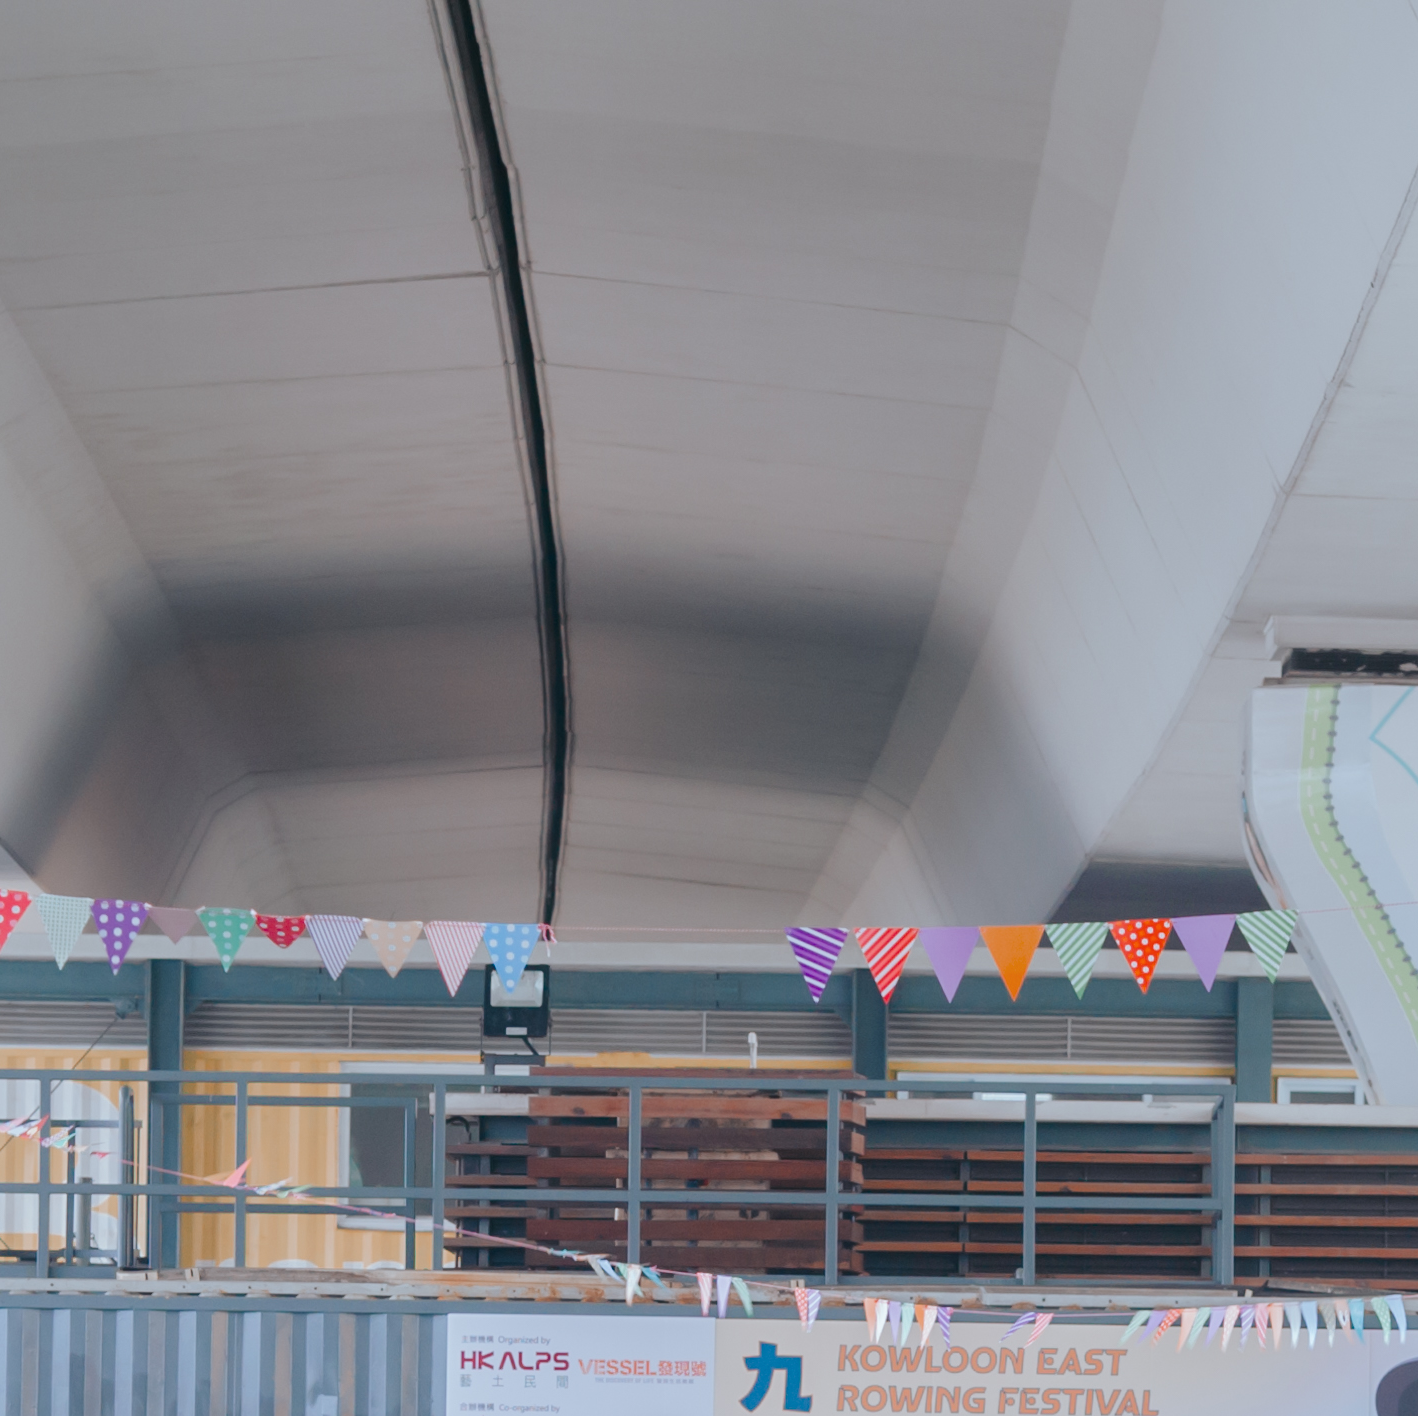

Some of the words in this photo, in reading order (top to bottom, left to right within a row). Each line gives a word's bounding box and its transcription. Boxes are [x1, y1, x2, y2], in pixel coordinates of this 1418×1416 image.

[498, 1335, 539, 1345] Organized
[541, 1335, 551, 1345] by
[578, 1359, 657, 1376] VESSEL
[837, 1344, 1023, 1375] KOWLOON
[1037, 1348, 1127, 1376] EAST
[498, 1403, 549, 1414] Co-organized
[550, 1403, 560, 1414] by
[836, 1385, 986, 1414] ROWING
[998, 1388, 1159, 1416] FESTIVAL
